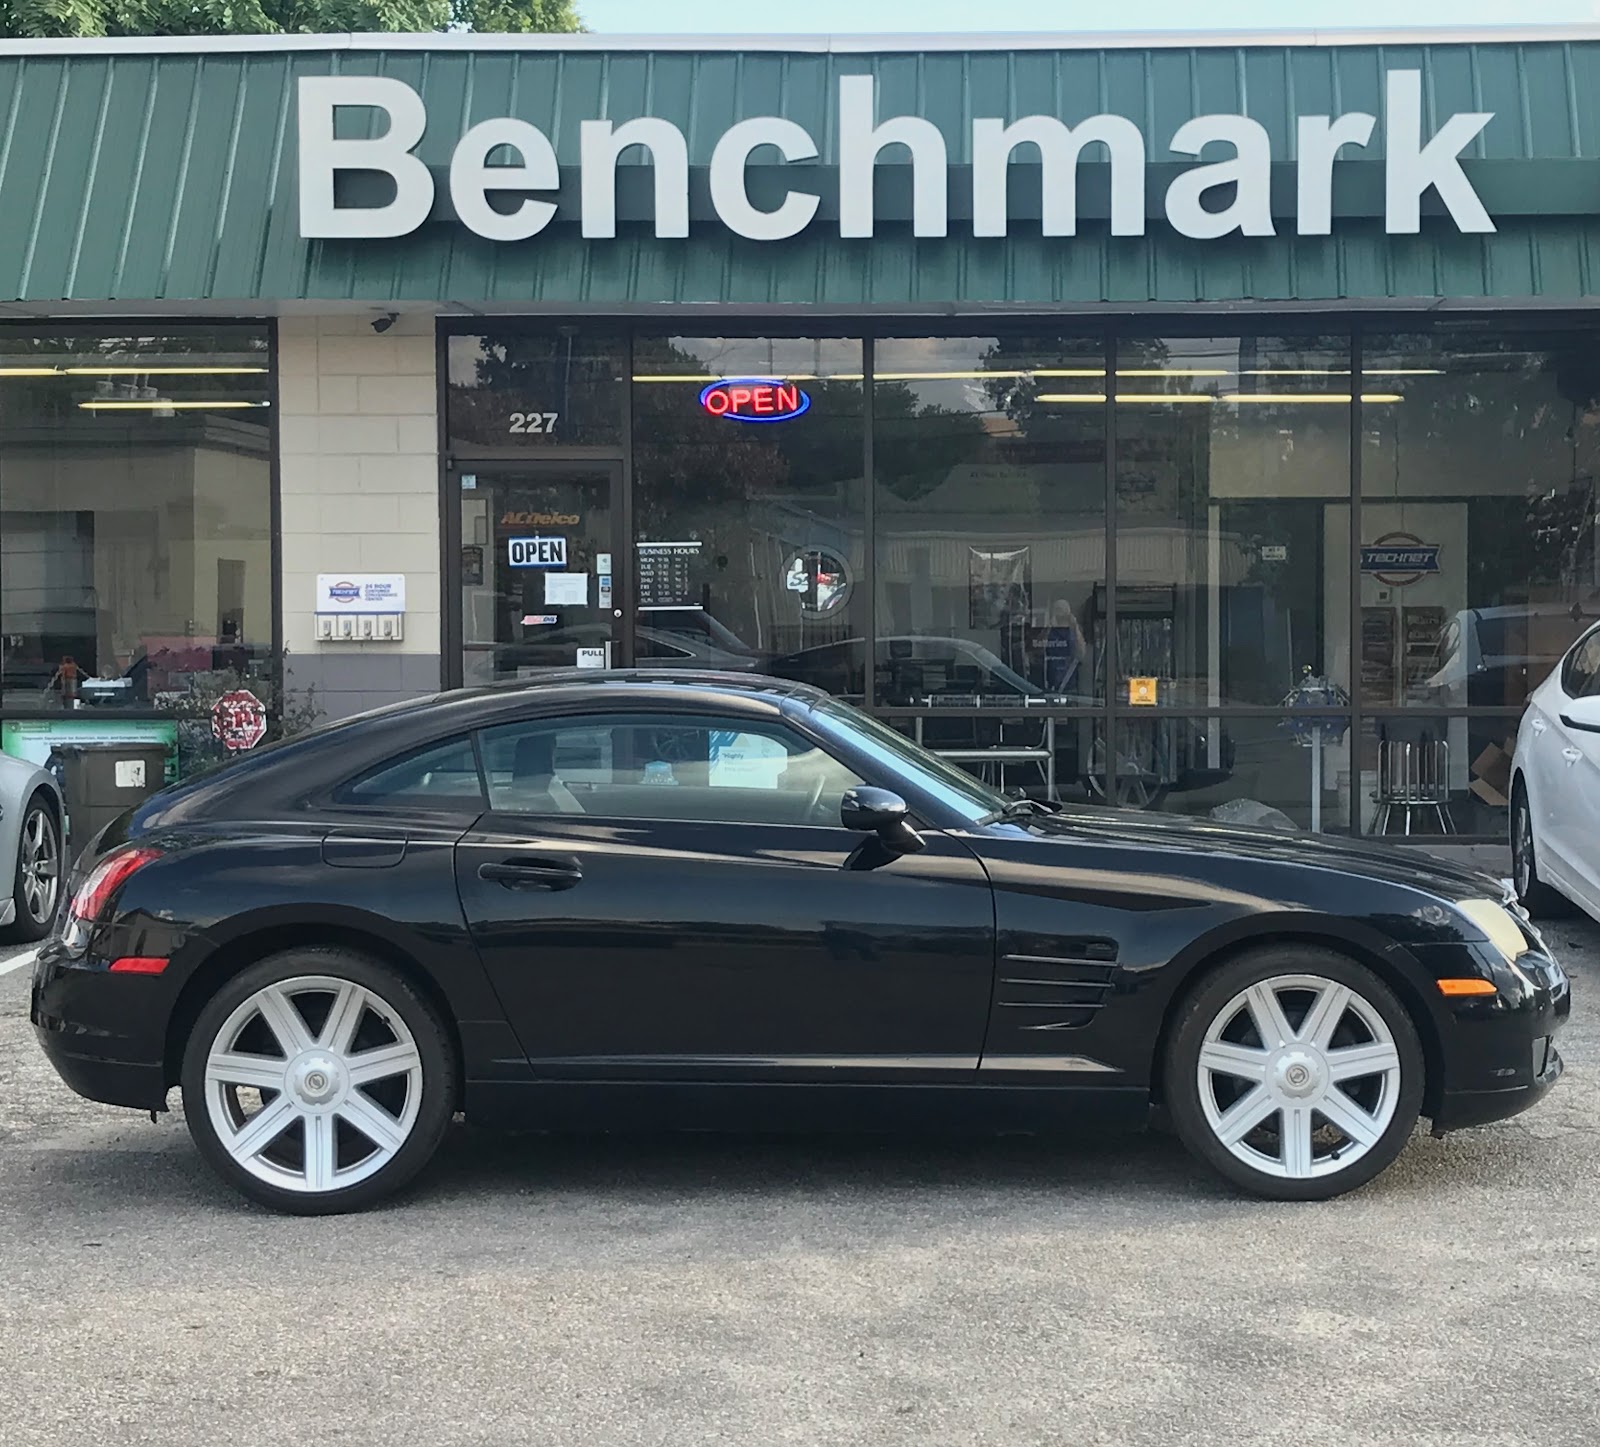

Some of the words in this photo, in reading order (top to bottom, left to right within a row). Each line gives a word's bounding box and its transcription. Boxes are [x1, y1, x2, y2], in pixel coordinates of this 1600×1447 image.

[297, 69, 1497, 242] Benchmark
[705, 386, 798, 415] OPEN
[509, 412, 559, 433] 227
[511, 541, 564, 563] OPEN
[673, 547, 700, 555] HOURS
